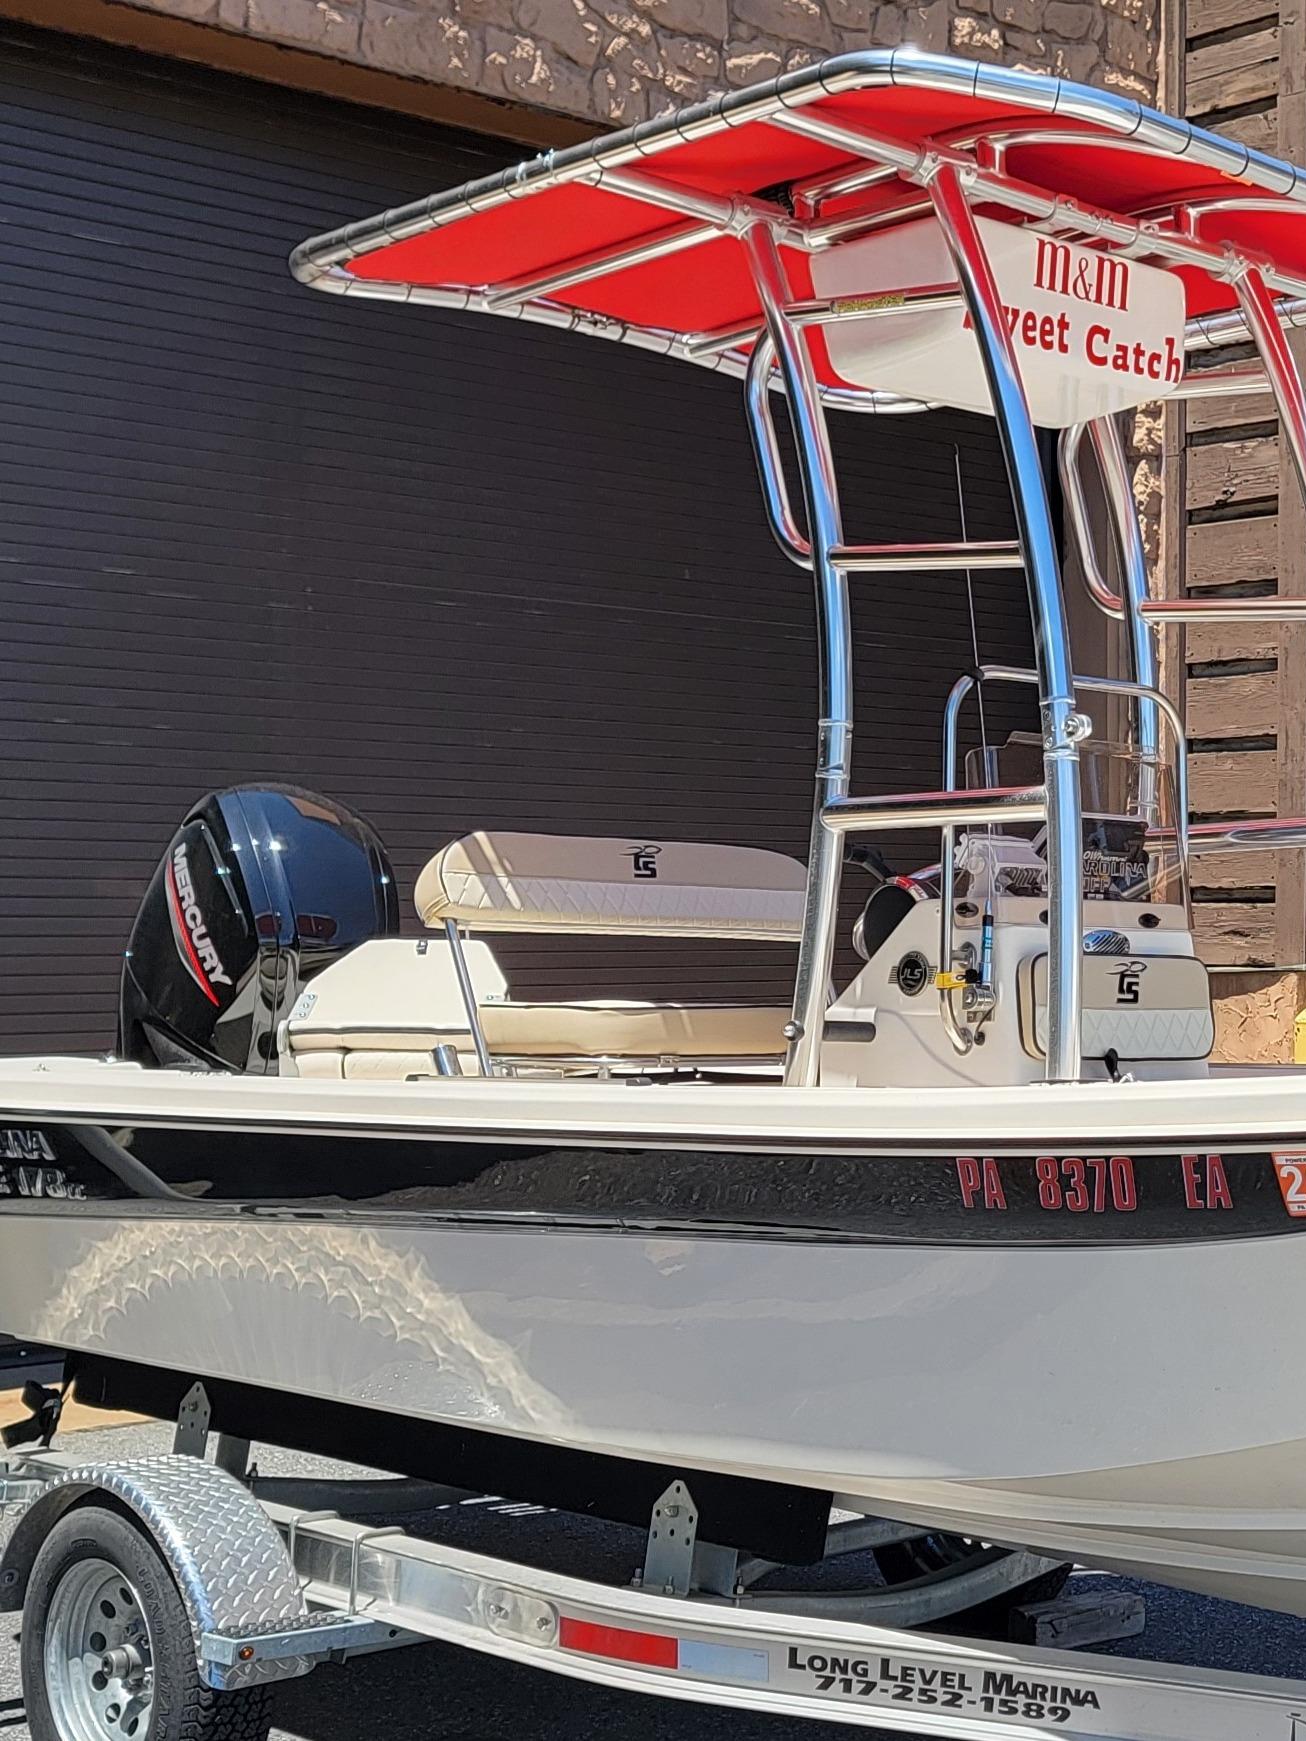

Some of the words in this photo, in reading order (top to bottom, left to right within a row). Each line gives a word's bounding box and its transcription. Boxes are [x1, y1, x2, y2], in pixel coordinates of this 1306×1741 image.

[963, 305, 1070, 353] weet
[1085, 324, 1182, 384] Catch
[1083, 860, 1147, 878] AROLINA
[173, 842, 233, 986] MERCURY
[955, 1157, 1007, 1210] PA
[1035, 1156, 1138, 1213] 8370
[1181, 1154, 1233, 1209] EA
[787, 1646, 869, 1679] LONG
[879, 1657, 973, 1692] LEVEL
[982, 1670, 1101, 1710] MARINA
[814, 1674, 1072, 1724] 717-252-1589
